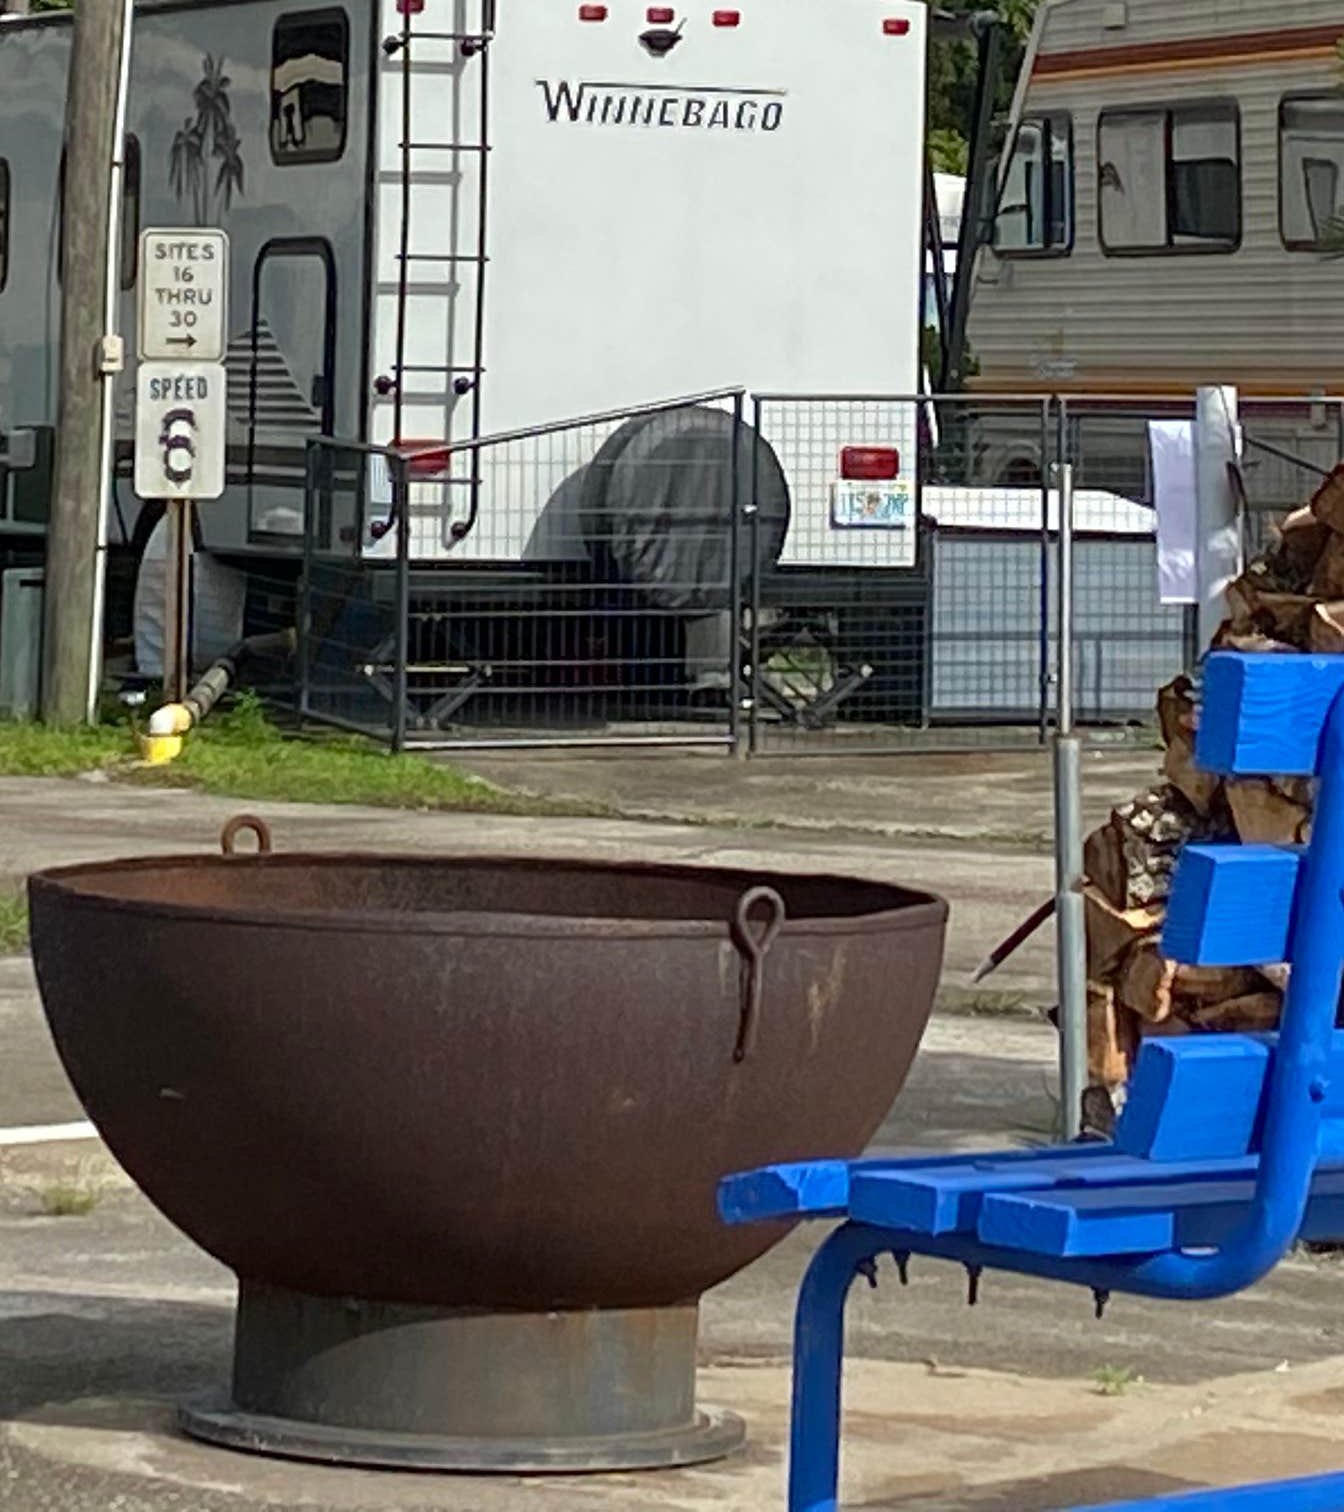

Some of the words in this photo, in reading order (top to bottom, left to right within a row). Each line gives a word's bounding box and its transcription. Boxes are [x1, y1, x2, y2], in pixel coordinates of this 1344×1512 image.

[536, 80, 786, 131] WINNEBAGO
[155, 243, 215, 260] SITES
[173, 266, 194, 282] 16
[155, 288, 212, 305] THRU
[168, 310, 197, 327] 30
[150, 375, 208, 400] SPEED
[159, 408, 197, 486] 6
